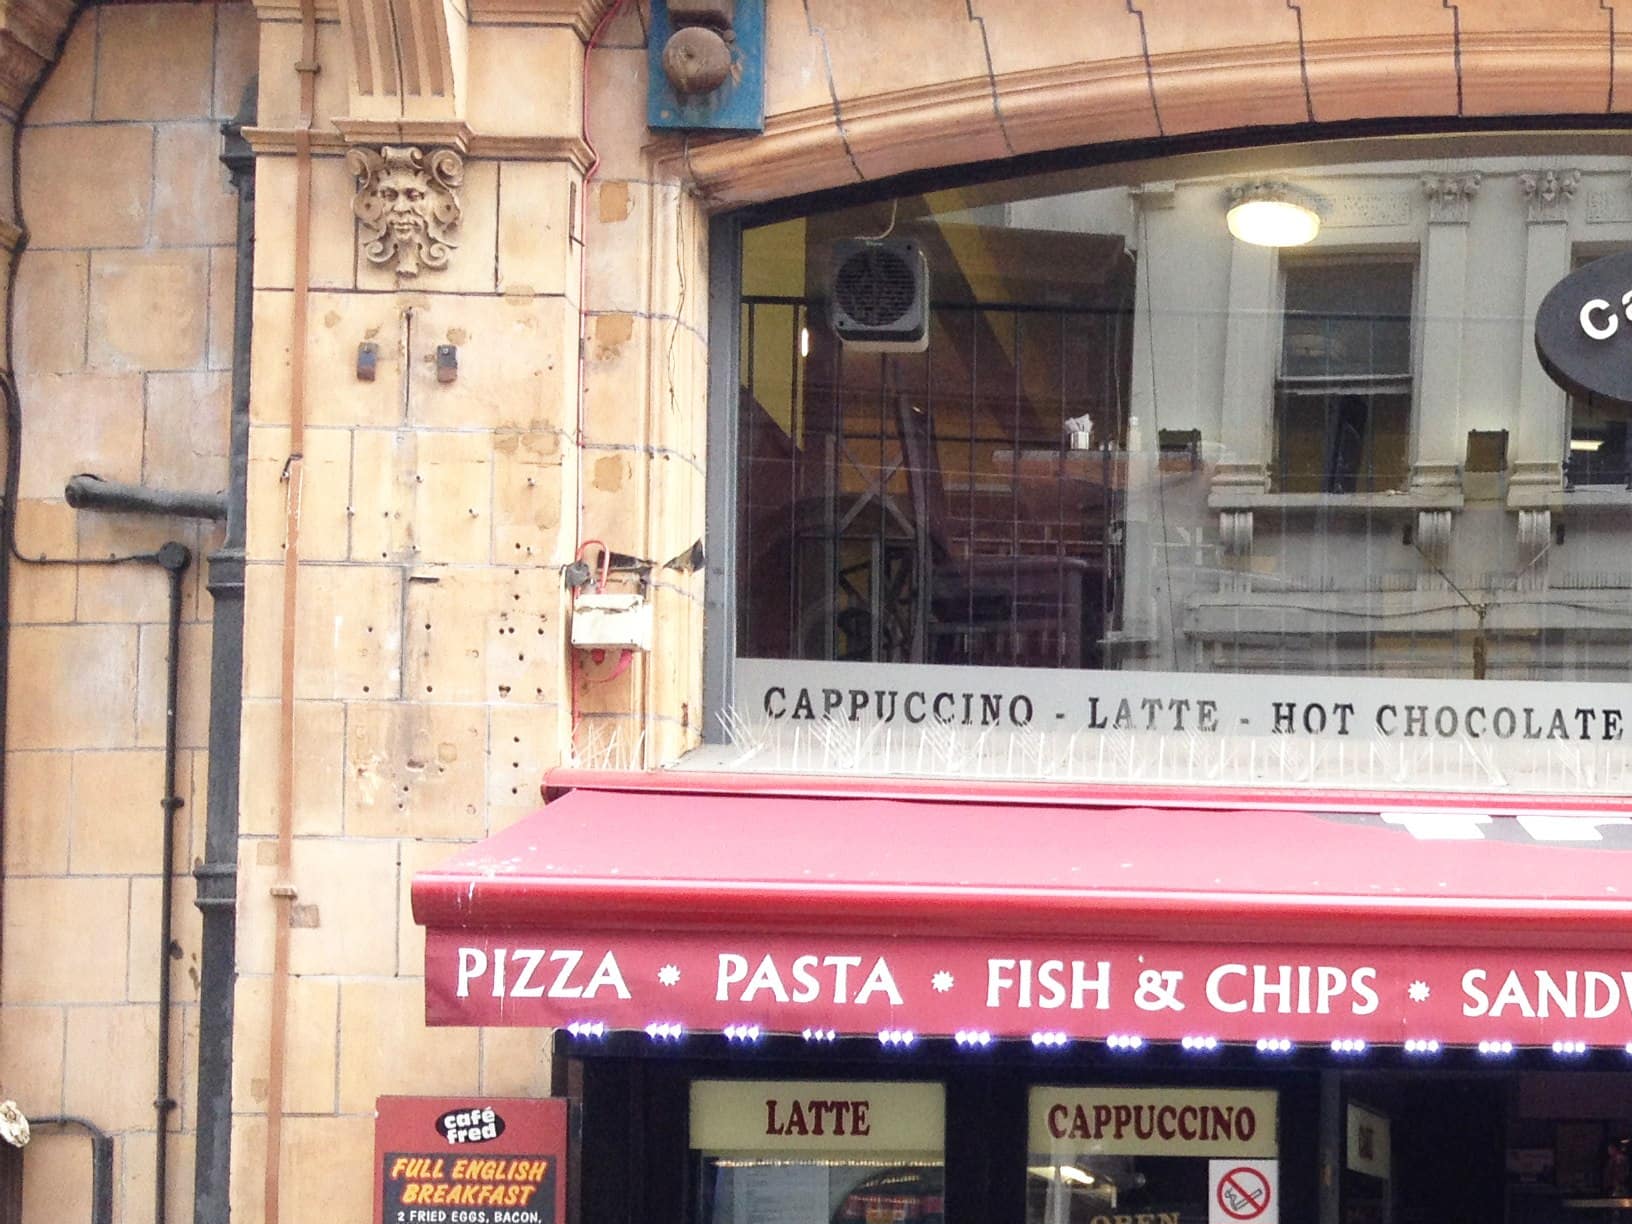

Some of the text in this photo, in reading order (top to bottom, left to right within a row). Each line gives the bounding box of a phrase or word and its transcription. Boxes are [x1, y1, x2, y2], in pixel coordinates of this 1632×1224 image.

[764, 686, 1033, 726] CAPPUCCINO
[1088, 697, 1219, 732] LATTE
[1271, 702, 1354, 735] HOT
[1377, 704, 1624, 740] CHOCOLATE
[457, 948, 631, 999] PIZZA
[715, 954, 903, 1004] PASTA
[986, 959, 1110, 1009] FISH
[1134, 970, 1185, 1011] &
[1205, 964, 1378, 1015] CHIPS
[444, 1107, 495, 1129] café
[765, 1100, 870, 1136] LATTE
[1048, 1104, 1256, 1141] CAPPUCCINO
[447, 1123, 496, 1144] fred
[392, 1158, 547, 1181] FULL ENGLISH
[402, 1184, 536, 1205] BREAKFAST
[397, 1211, 542, 1224] 2 FRIED EGGS, BACON,
